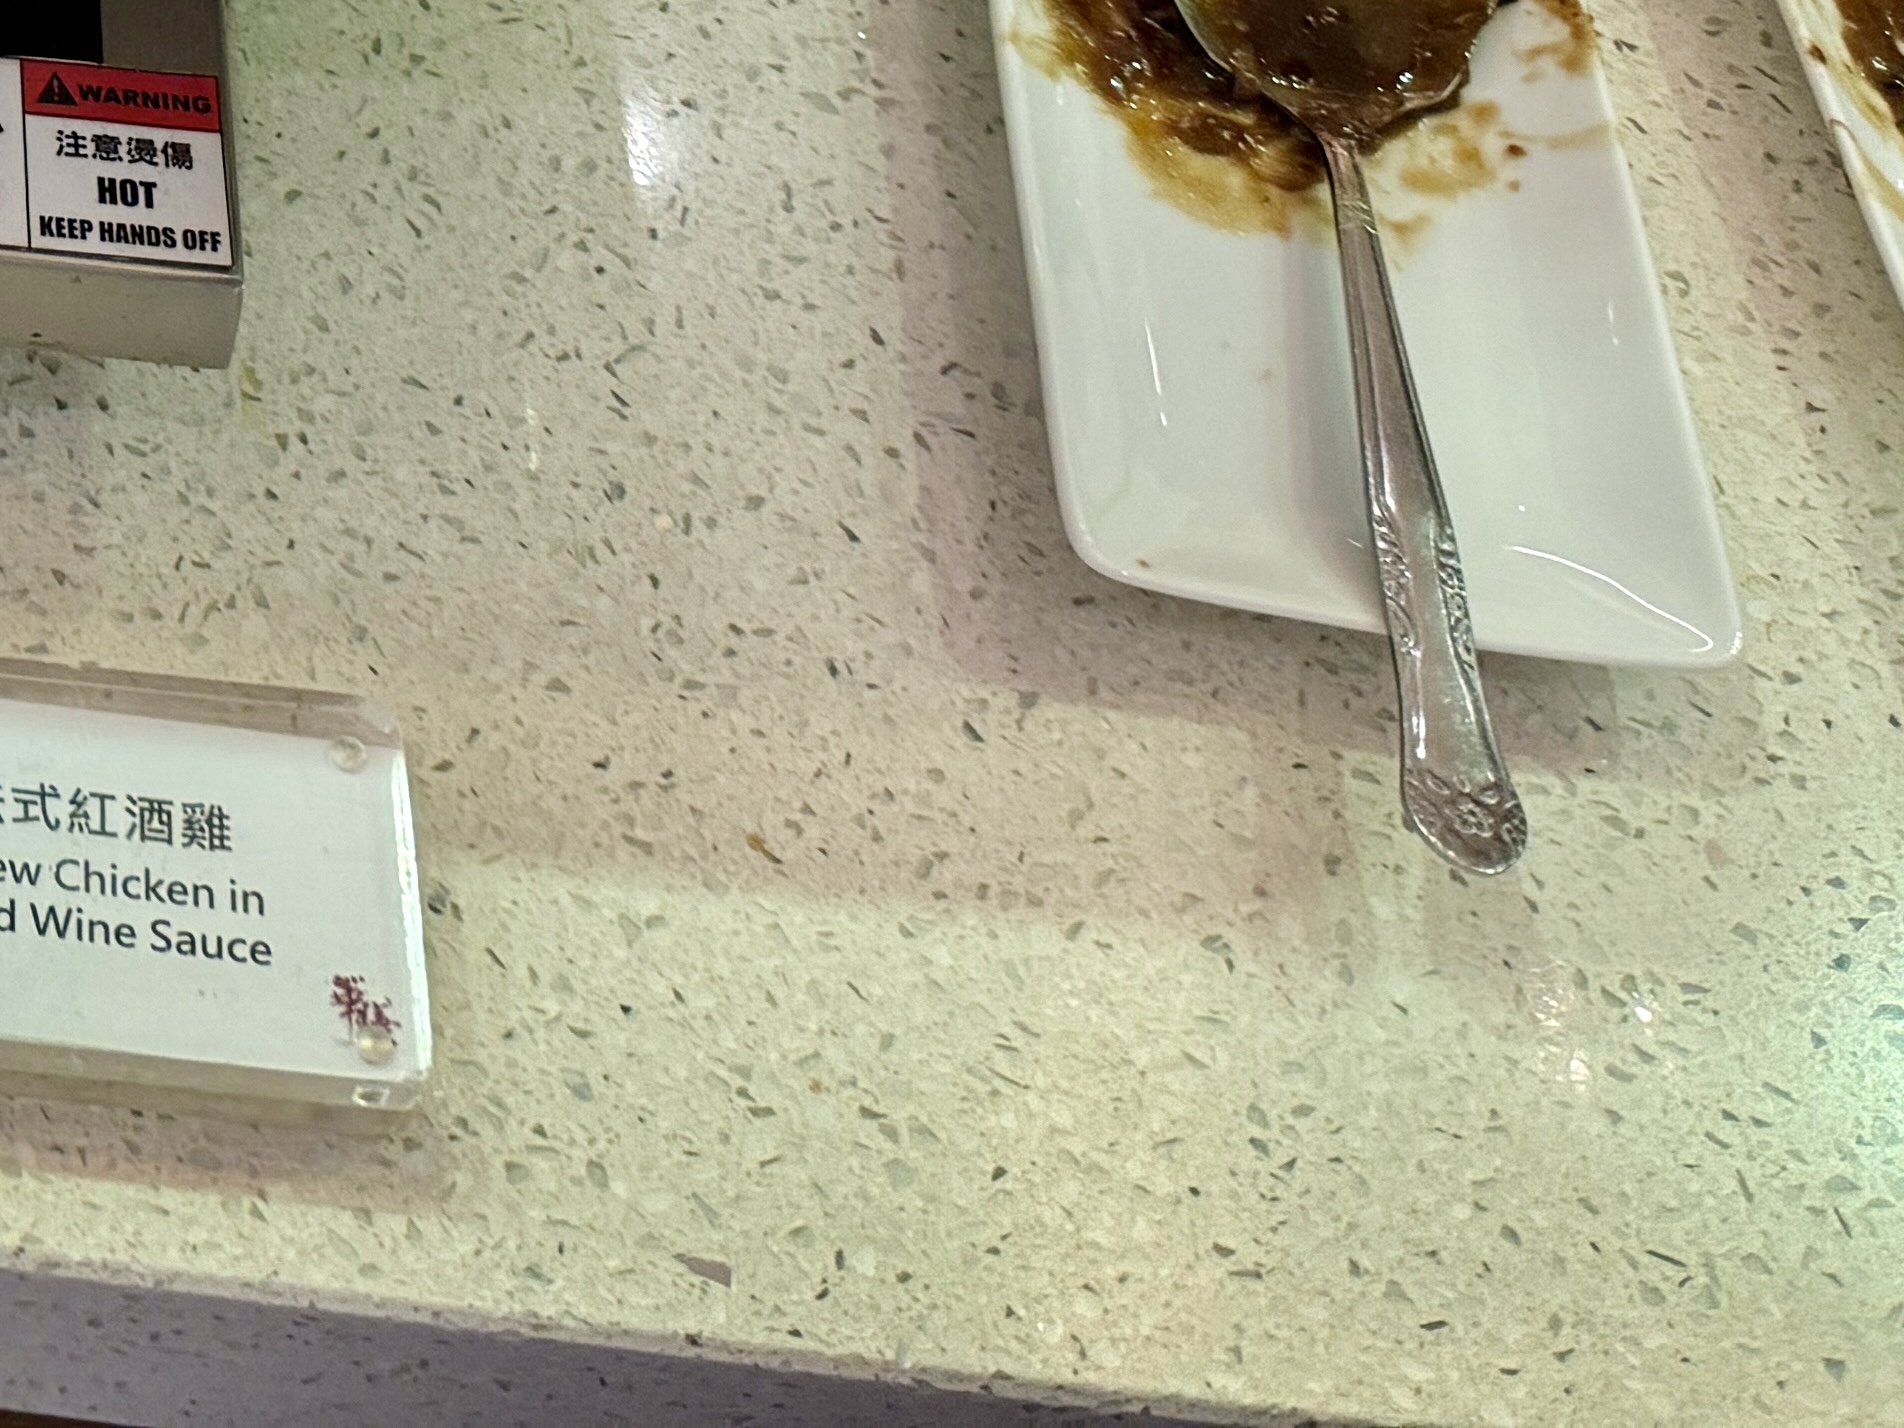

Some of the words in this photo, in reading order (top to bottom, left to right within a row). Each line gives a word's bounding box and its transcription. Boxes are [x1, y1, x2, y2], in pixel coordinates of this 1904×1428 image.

[78, 83, 212, 114] WARNING
[55, 129, 194, 170] 注意燙傷
[96, 176, 158, 209] HOT
[39, 215, 94, 240] KEEP
[99, 221, 177, 248] HANDS
[182, 229, 222, 252] OFF
[52, 858, 216, 910] Chicken
[228, 877, 266, 917] in
[28, 900, 137, 949] Wine
[149, 918, 273, 966] Sauce
